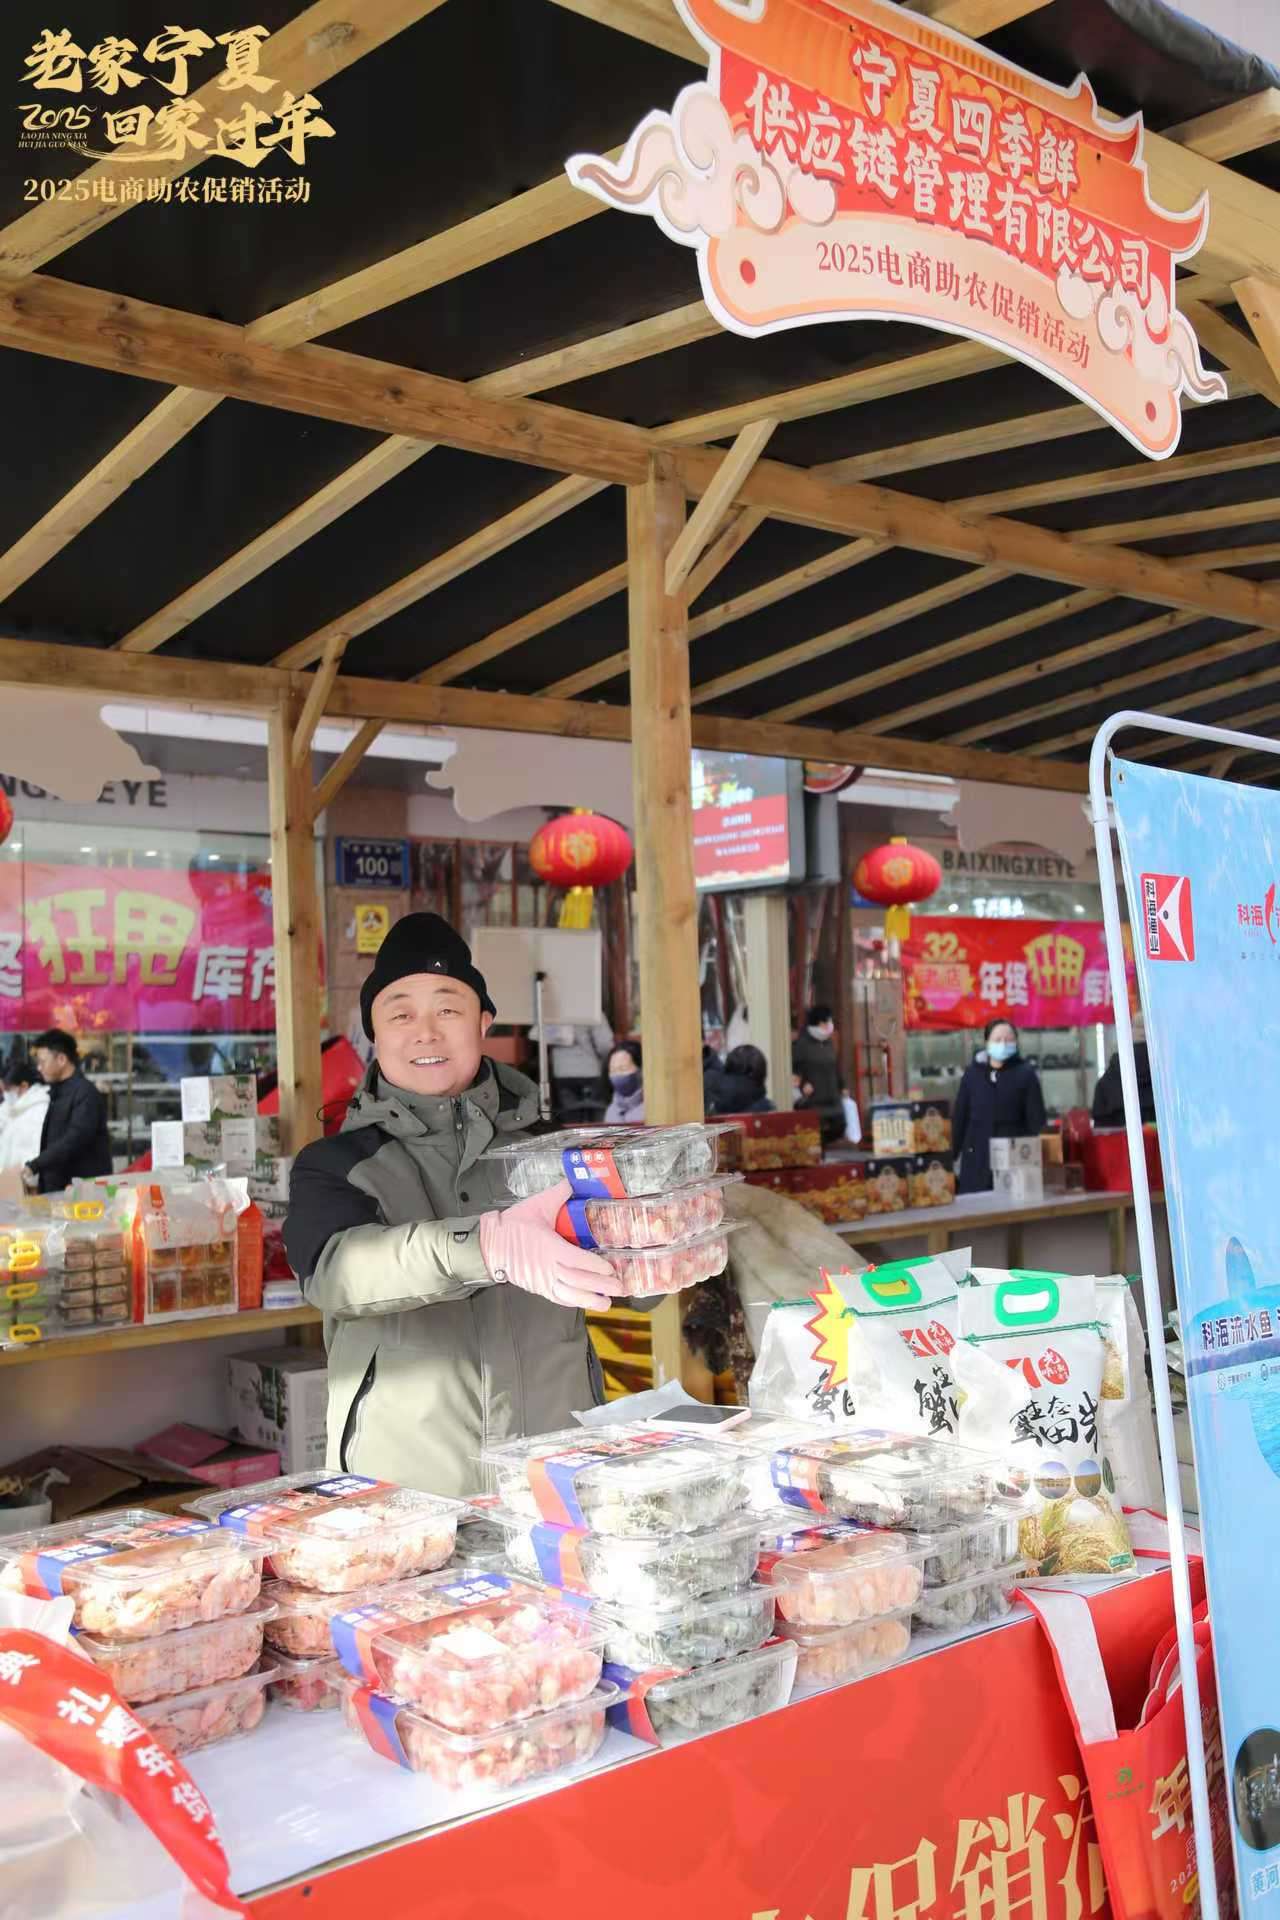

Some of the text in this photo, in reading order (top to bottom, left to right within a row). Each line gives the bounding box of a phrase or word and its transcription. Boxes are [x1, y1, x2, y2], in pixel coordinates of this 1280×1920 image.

[745, 70, 1153, 306] 供应链管理有限公司
[852, 41, 1080, 199] 宁夏四季鲜
[815, 241, 1091, 370] 2025电商助农促销活动
[1201, 1310, 1273, 1350] 科海流水鱼
